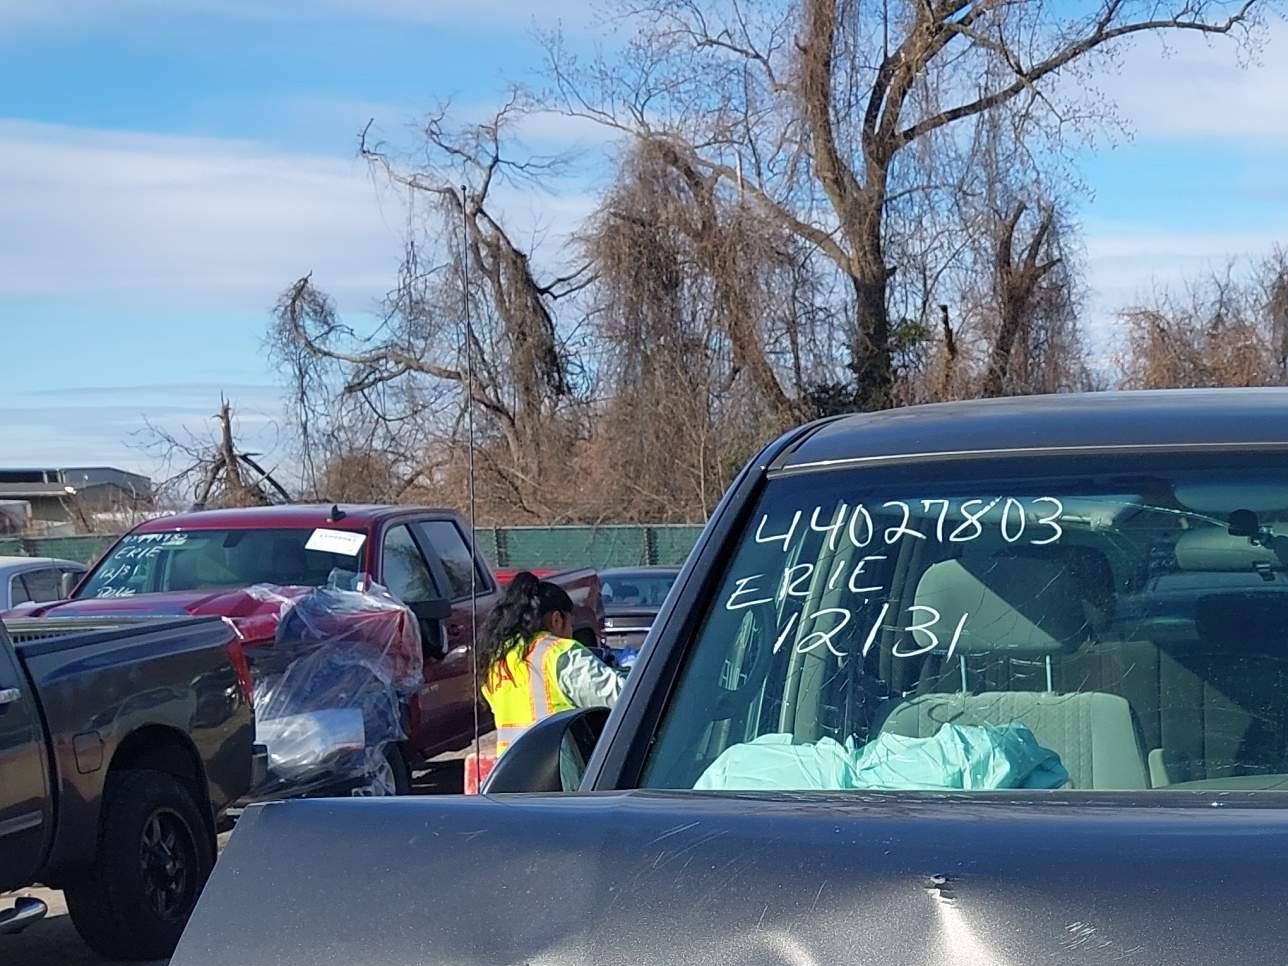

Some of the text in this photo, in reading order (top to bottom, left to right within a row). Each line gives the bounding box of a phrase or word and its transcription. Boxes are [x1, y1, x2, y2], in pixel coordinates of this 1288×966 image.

[755, 496, 1064, 552] 44027803
[114, 545, 163, 560] ERIE
[726, 555, 888, 610] ERIE
